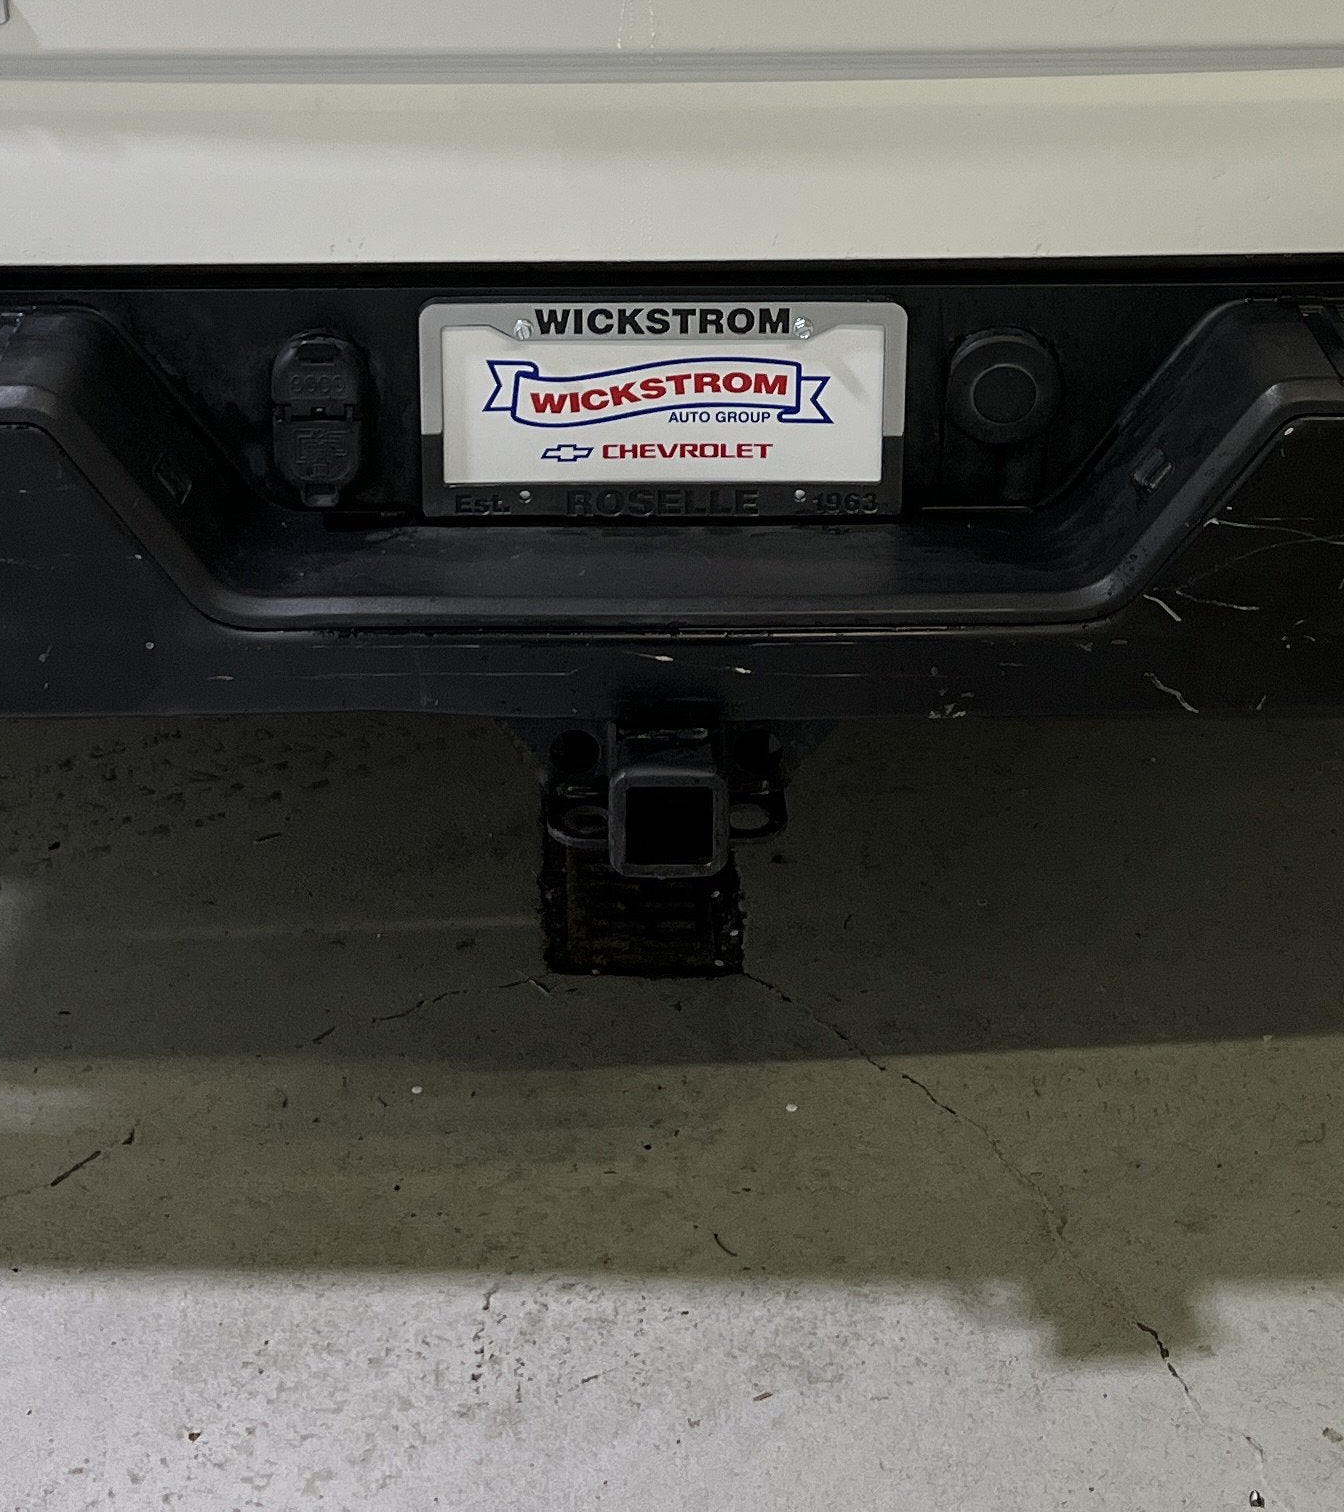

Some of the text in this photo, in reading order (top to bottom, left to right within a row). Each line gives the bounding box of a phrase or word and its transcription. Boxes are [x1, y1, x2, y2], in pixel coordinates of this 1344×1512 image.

[534, 307, 791, 335] WICKSTROM
[529, 372, 789, 414] WICKSTROM
[668, 411, 771, 423] AUTO GROUP
[602, 443, 774, 459] CHEVROLET
[455, 494, 511, 515] Est.
[565, 489, 760, 517] ROSELLE
